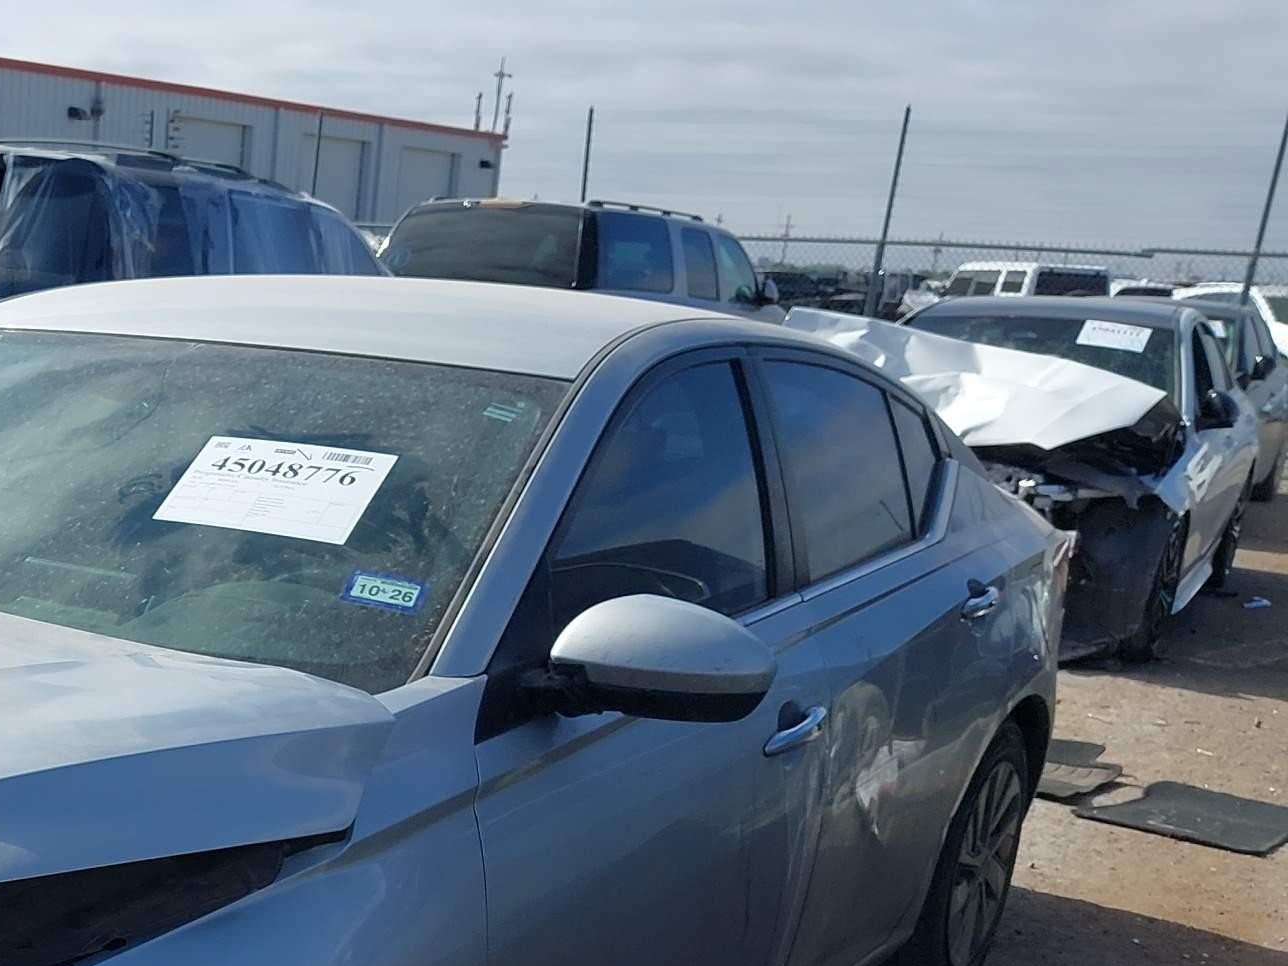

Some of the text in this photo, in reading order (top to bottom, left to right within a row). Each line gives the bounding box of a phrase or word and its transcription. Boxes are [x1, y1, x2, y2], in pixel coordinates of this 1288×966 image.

[211, 456, 360, 487] 45048776
[359, 584, 415, 604] 10 26
